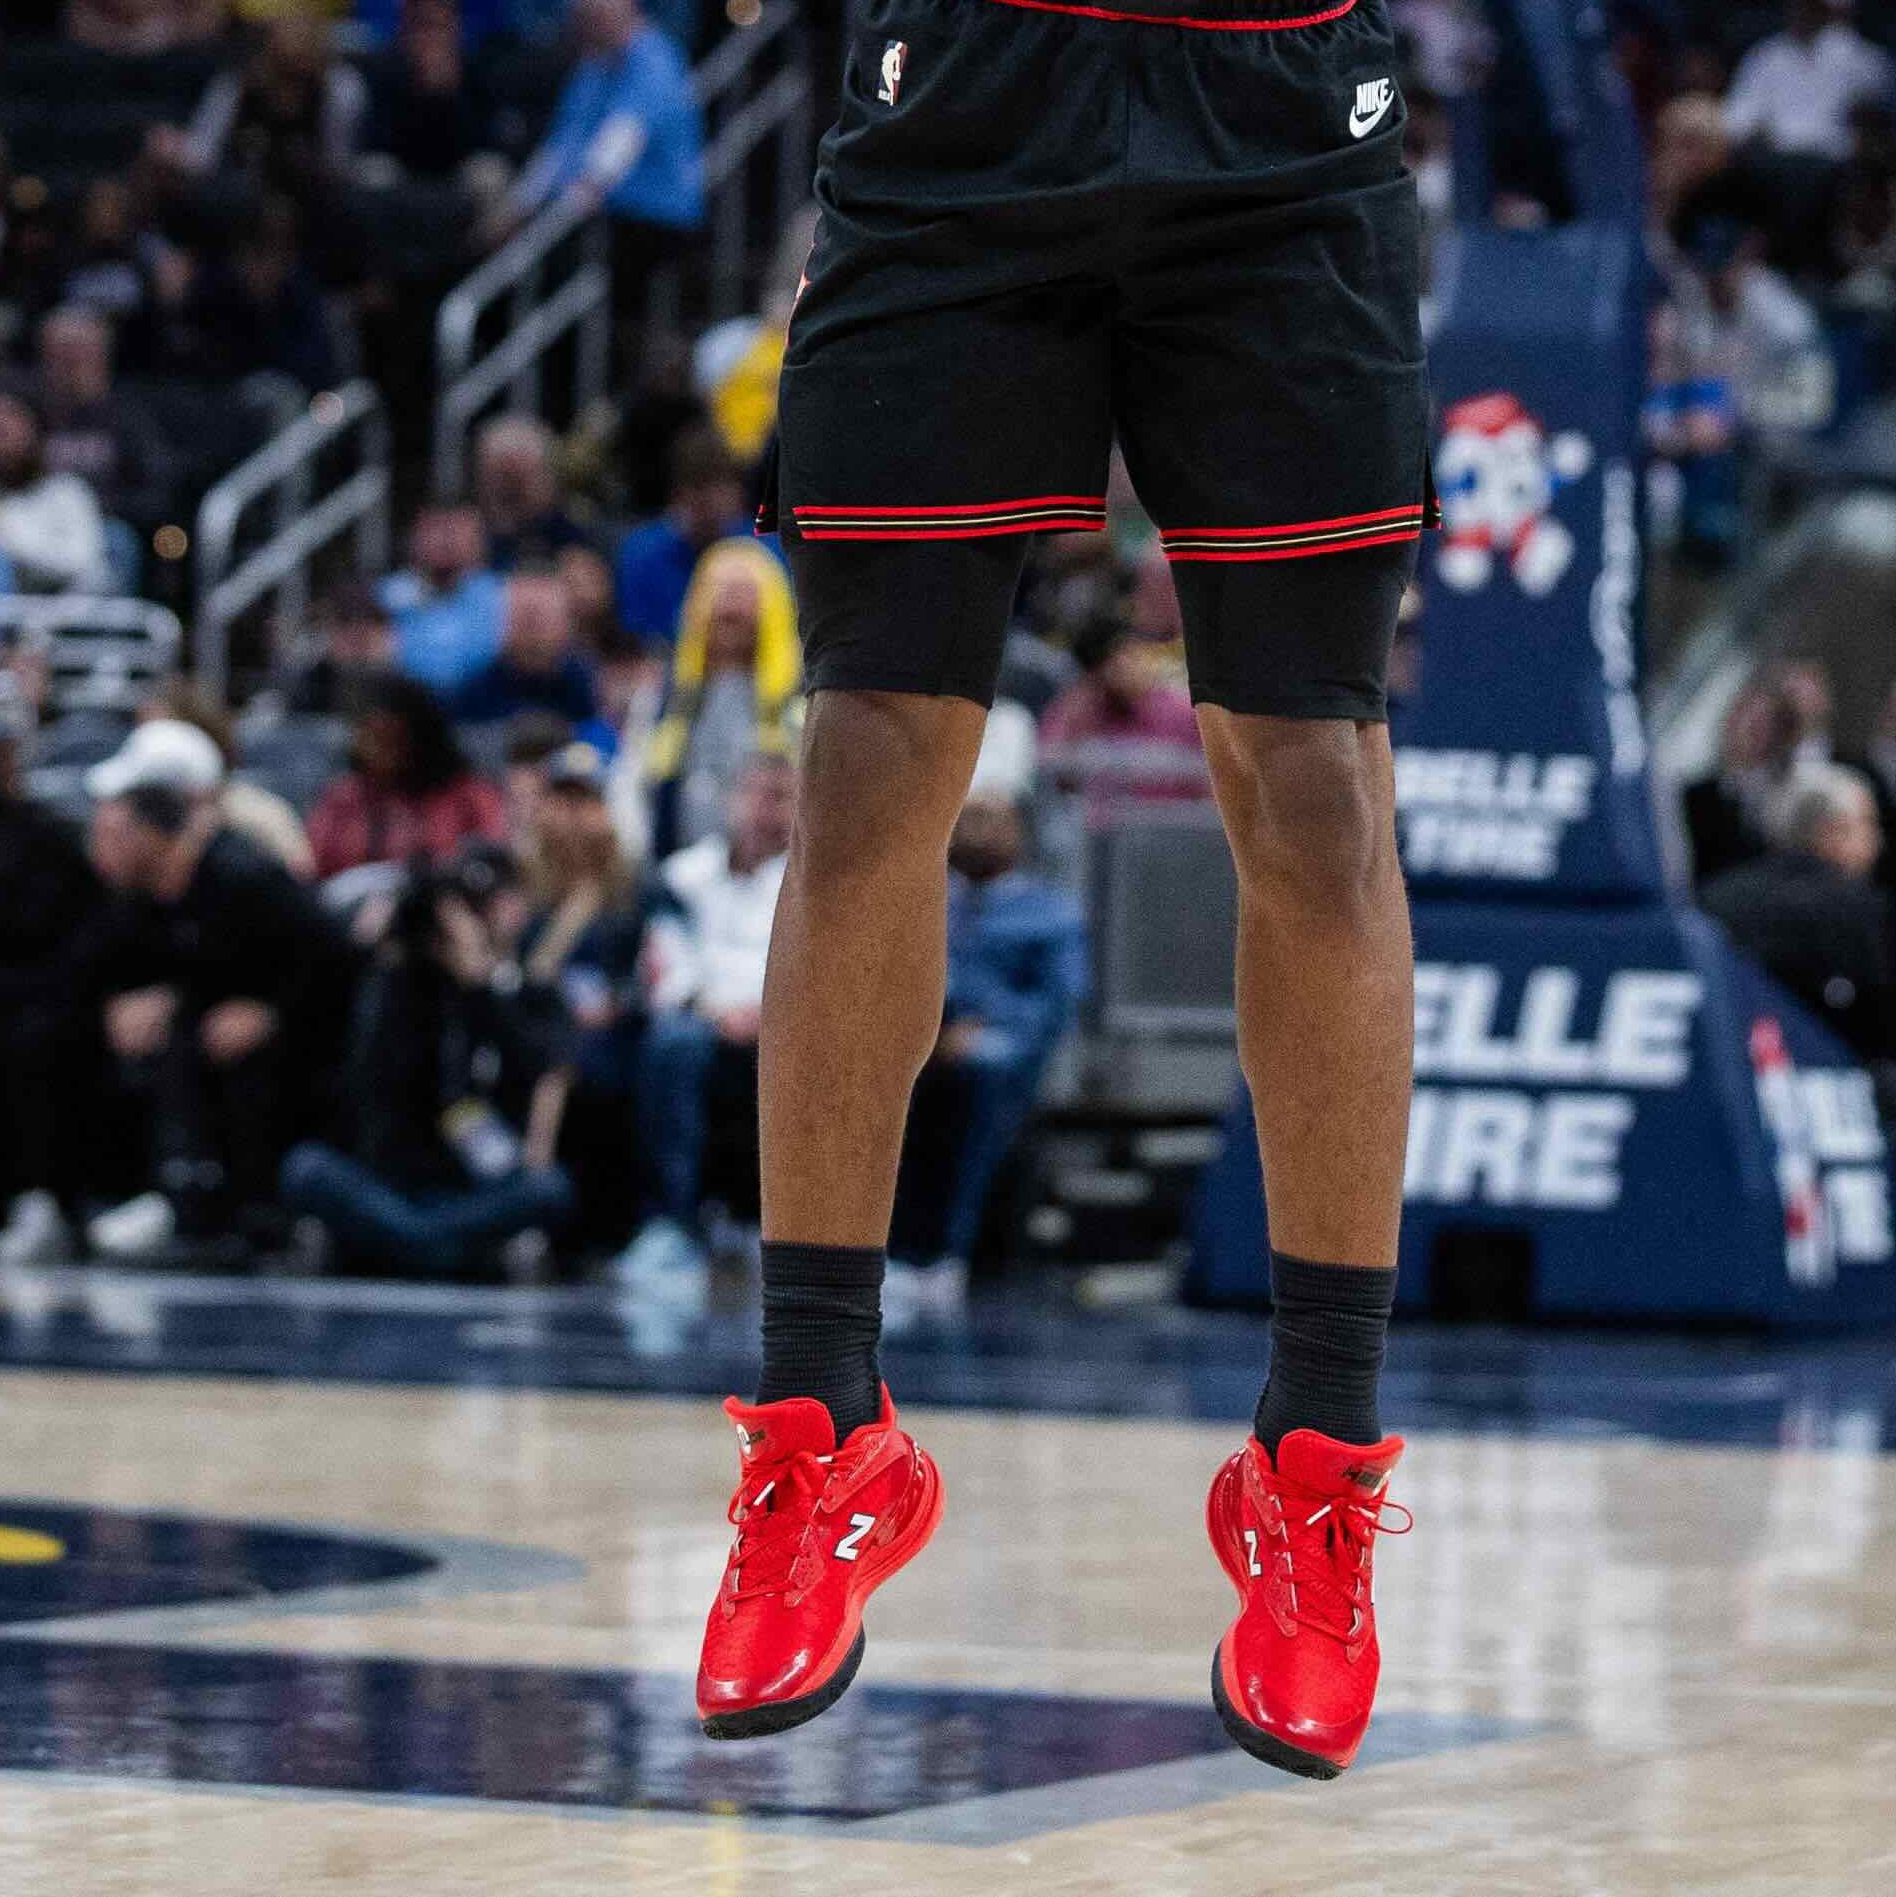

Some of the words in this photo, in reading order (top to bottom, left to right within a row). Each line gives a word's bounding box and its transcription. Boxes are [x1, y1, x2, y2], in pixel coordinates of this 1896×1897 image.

[1355, 77, 1391, 117] NIKE
[1413, 962, 1705, 1089] ELLE
[1402, 1088, 1637, 1210] IRE
